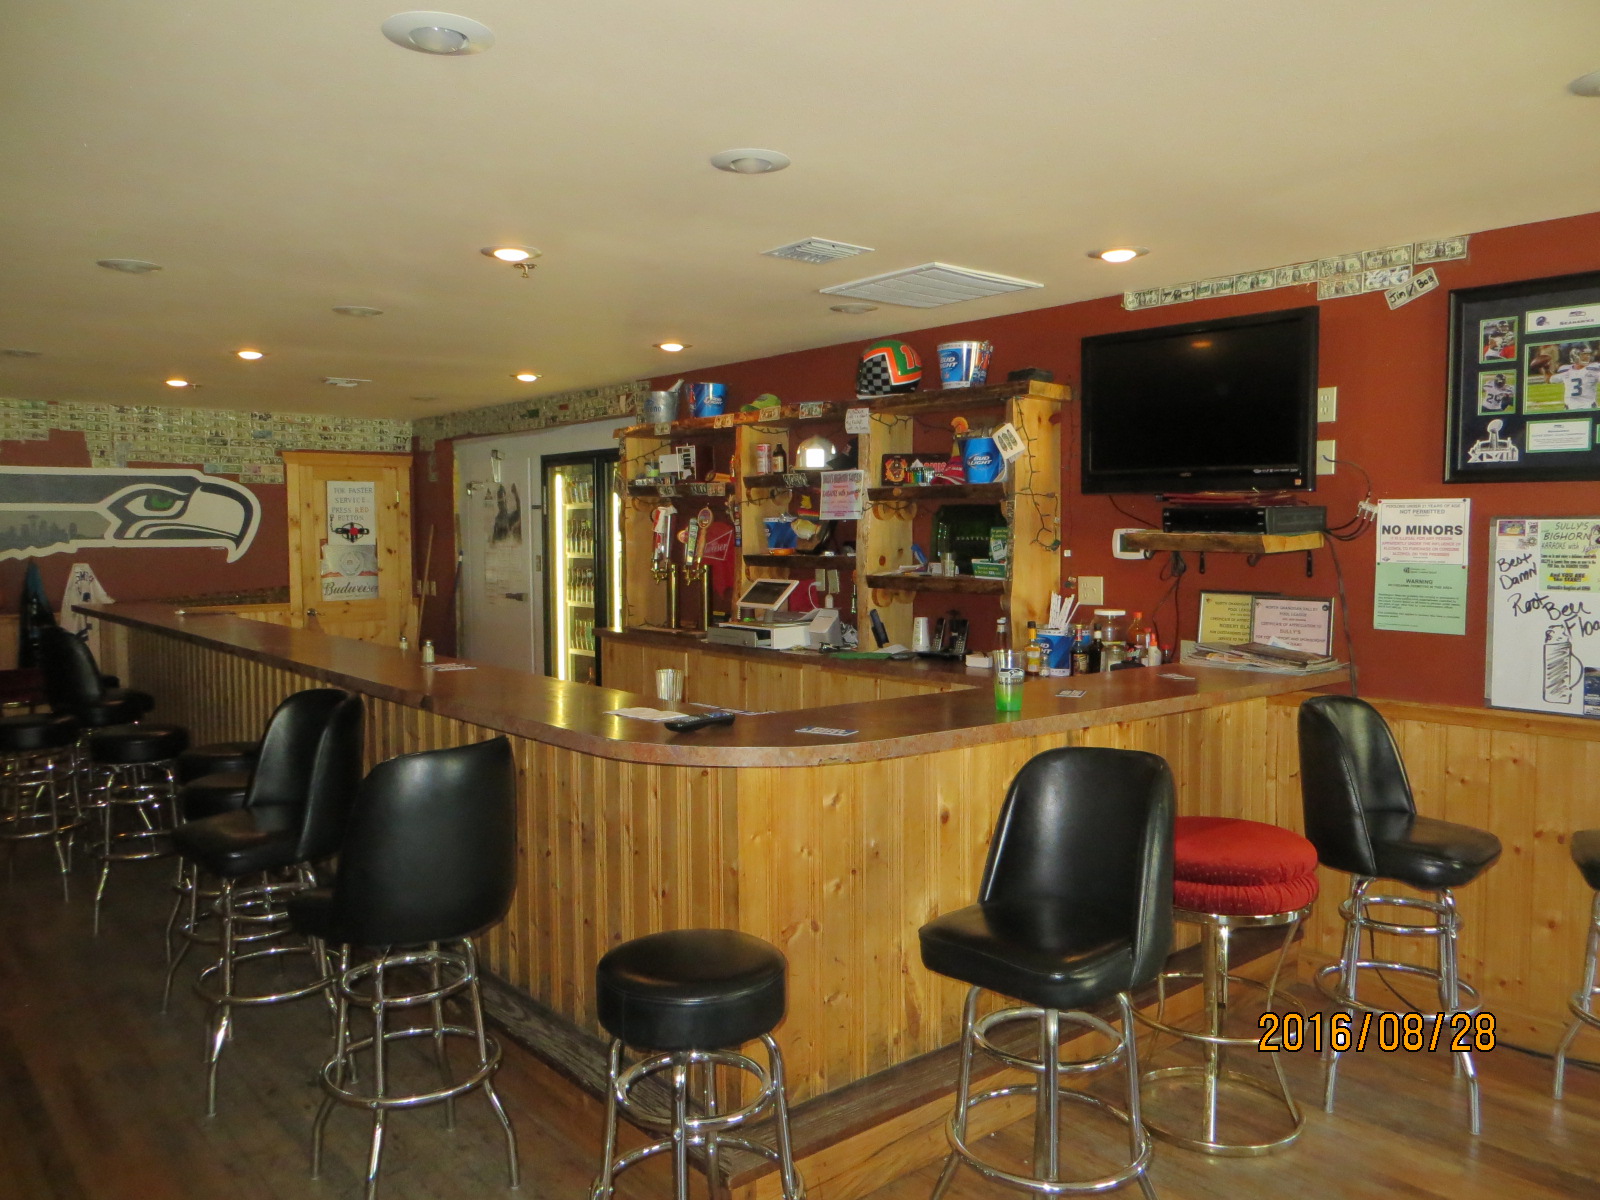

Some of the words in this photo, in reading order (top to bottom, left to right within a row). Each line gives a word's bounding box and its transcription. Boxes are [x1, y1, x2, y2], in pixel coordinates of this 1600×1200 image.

[1571, 377, 1584, 397] 3
[331, 506, 352, 514] PRESS
[1382, 525, 1401, 535] NO
[1406, 525, 1463, 536] MINORS
[1555, 521, 1589, 530] SULLY'S
[1543, 532, 1590, 541] BIGHORN
[1497, 553, 1532, 572] Best
[1507, 592, 1549, 617] Root
[1542, 601, 1591, 620] Beer
[1564, 614, 1600, 637] Floa
